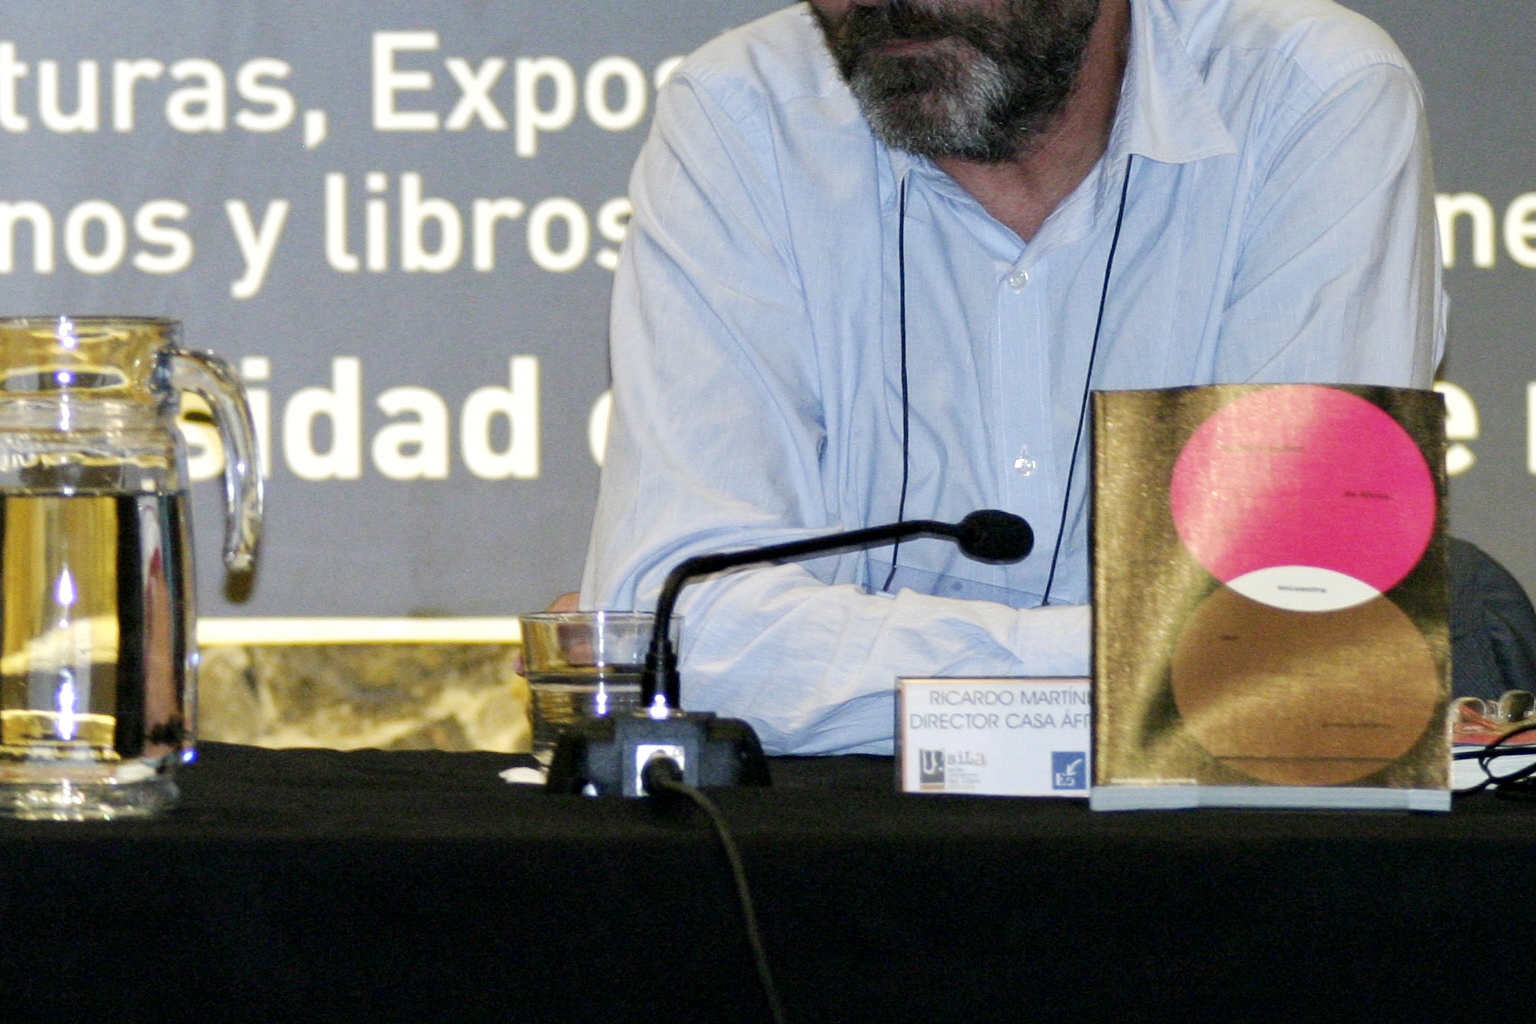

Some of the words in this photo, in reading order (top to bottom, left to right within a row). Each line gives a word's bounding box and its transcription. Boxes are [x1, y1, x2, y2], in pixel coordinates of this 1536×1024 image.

[225, 200, 289, 298] y
[325, 173, 632, 272] libros
[929, 689, 1014, 706] RICARDO
[910, 713, 1000, 730] DIRECTOR
[1005, 713, 1055, 729] CASA
